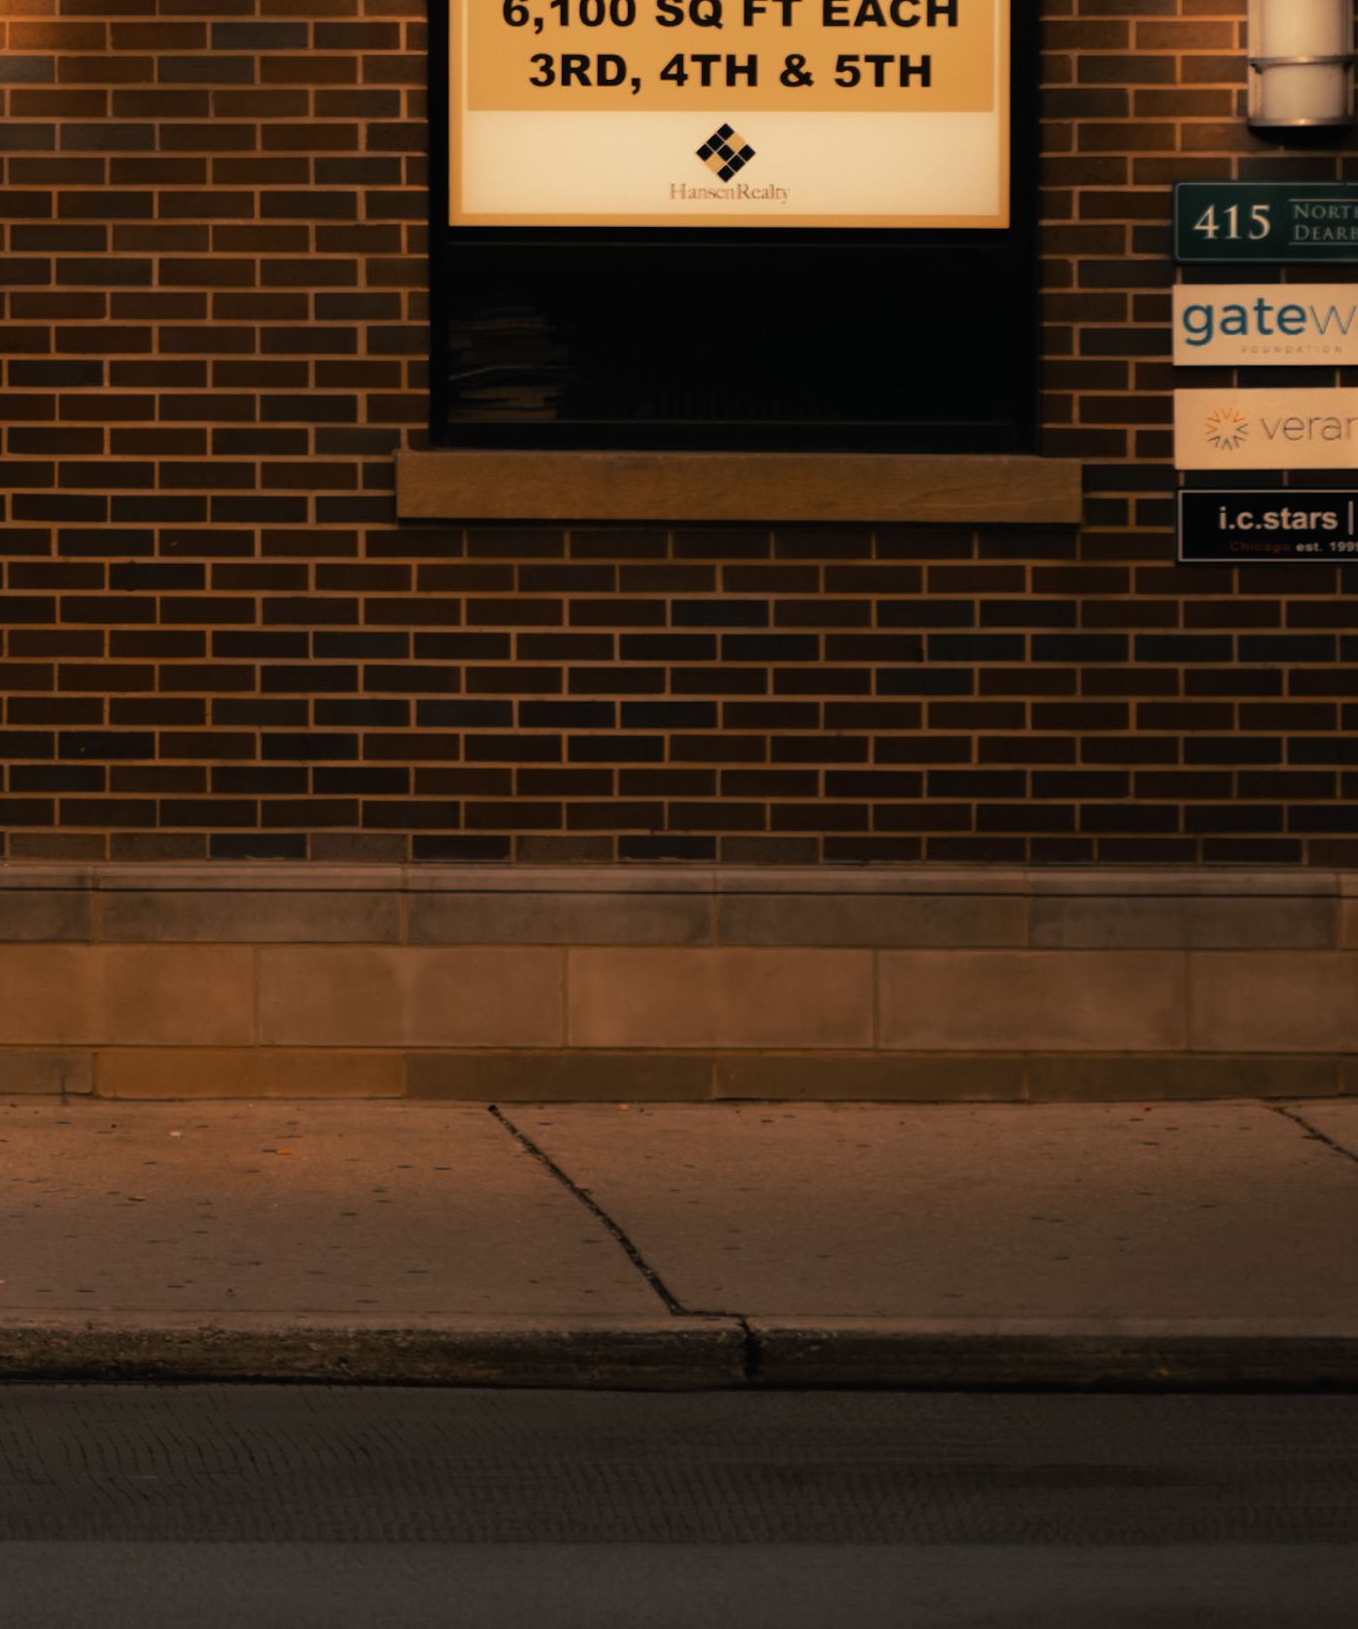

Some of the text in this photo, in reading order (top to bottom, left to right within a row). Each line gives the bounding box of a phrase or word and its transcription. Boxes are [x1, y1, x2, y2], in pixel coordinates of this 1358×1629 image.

[528, 52, 932, 95] 3RD, 4TH & 5TH
[1192, 203, 1272, 240] 415
[1240, 345, 1343, 354] FOUNDATION
[1218, 504, 1340, 531] i.c.stars
